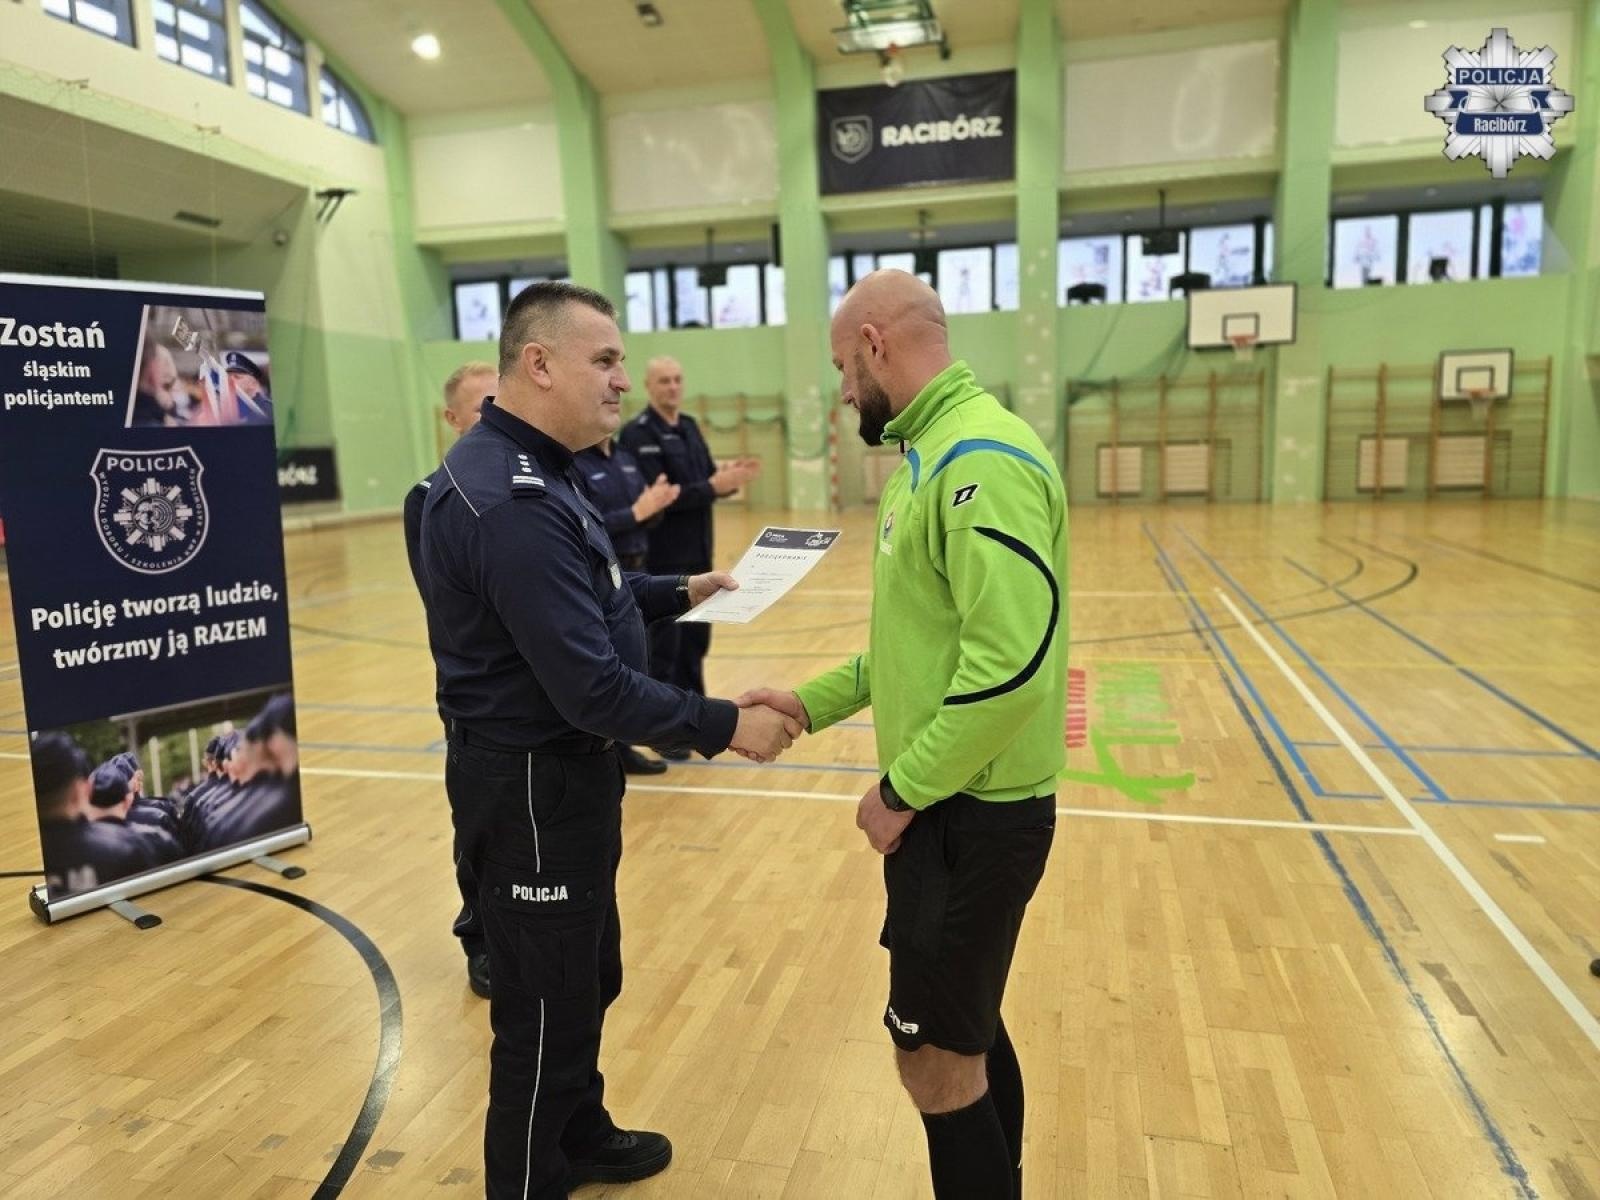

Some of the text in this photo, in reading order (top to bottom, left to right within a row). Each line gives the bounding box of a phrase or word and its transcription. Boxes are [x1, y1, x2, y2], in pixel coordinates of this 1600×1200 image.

[880, 113, 1003, 147] RACIBÓRZ
[0, 317, 106, 349] Zostań
[23, 361, 91, 381] śląskim
[4, 390, 115, 411] policjantem!
[106, 455, 188, 472] POLICJA
[31, 580, 279, 631] Policję tworzą ludzie,
[53, 616, 267, 669] twórzmy ją RAZEM
[511, 883, 569, 902] POLICJA
